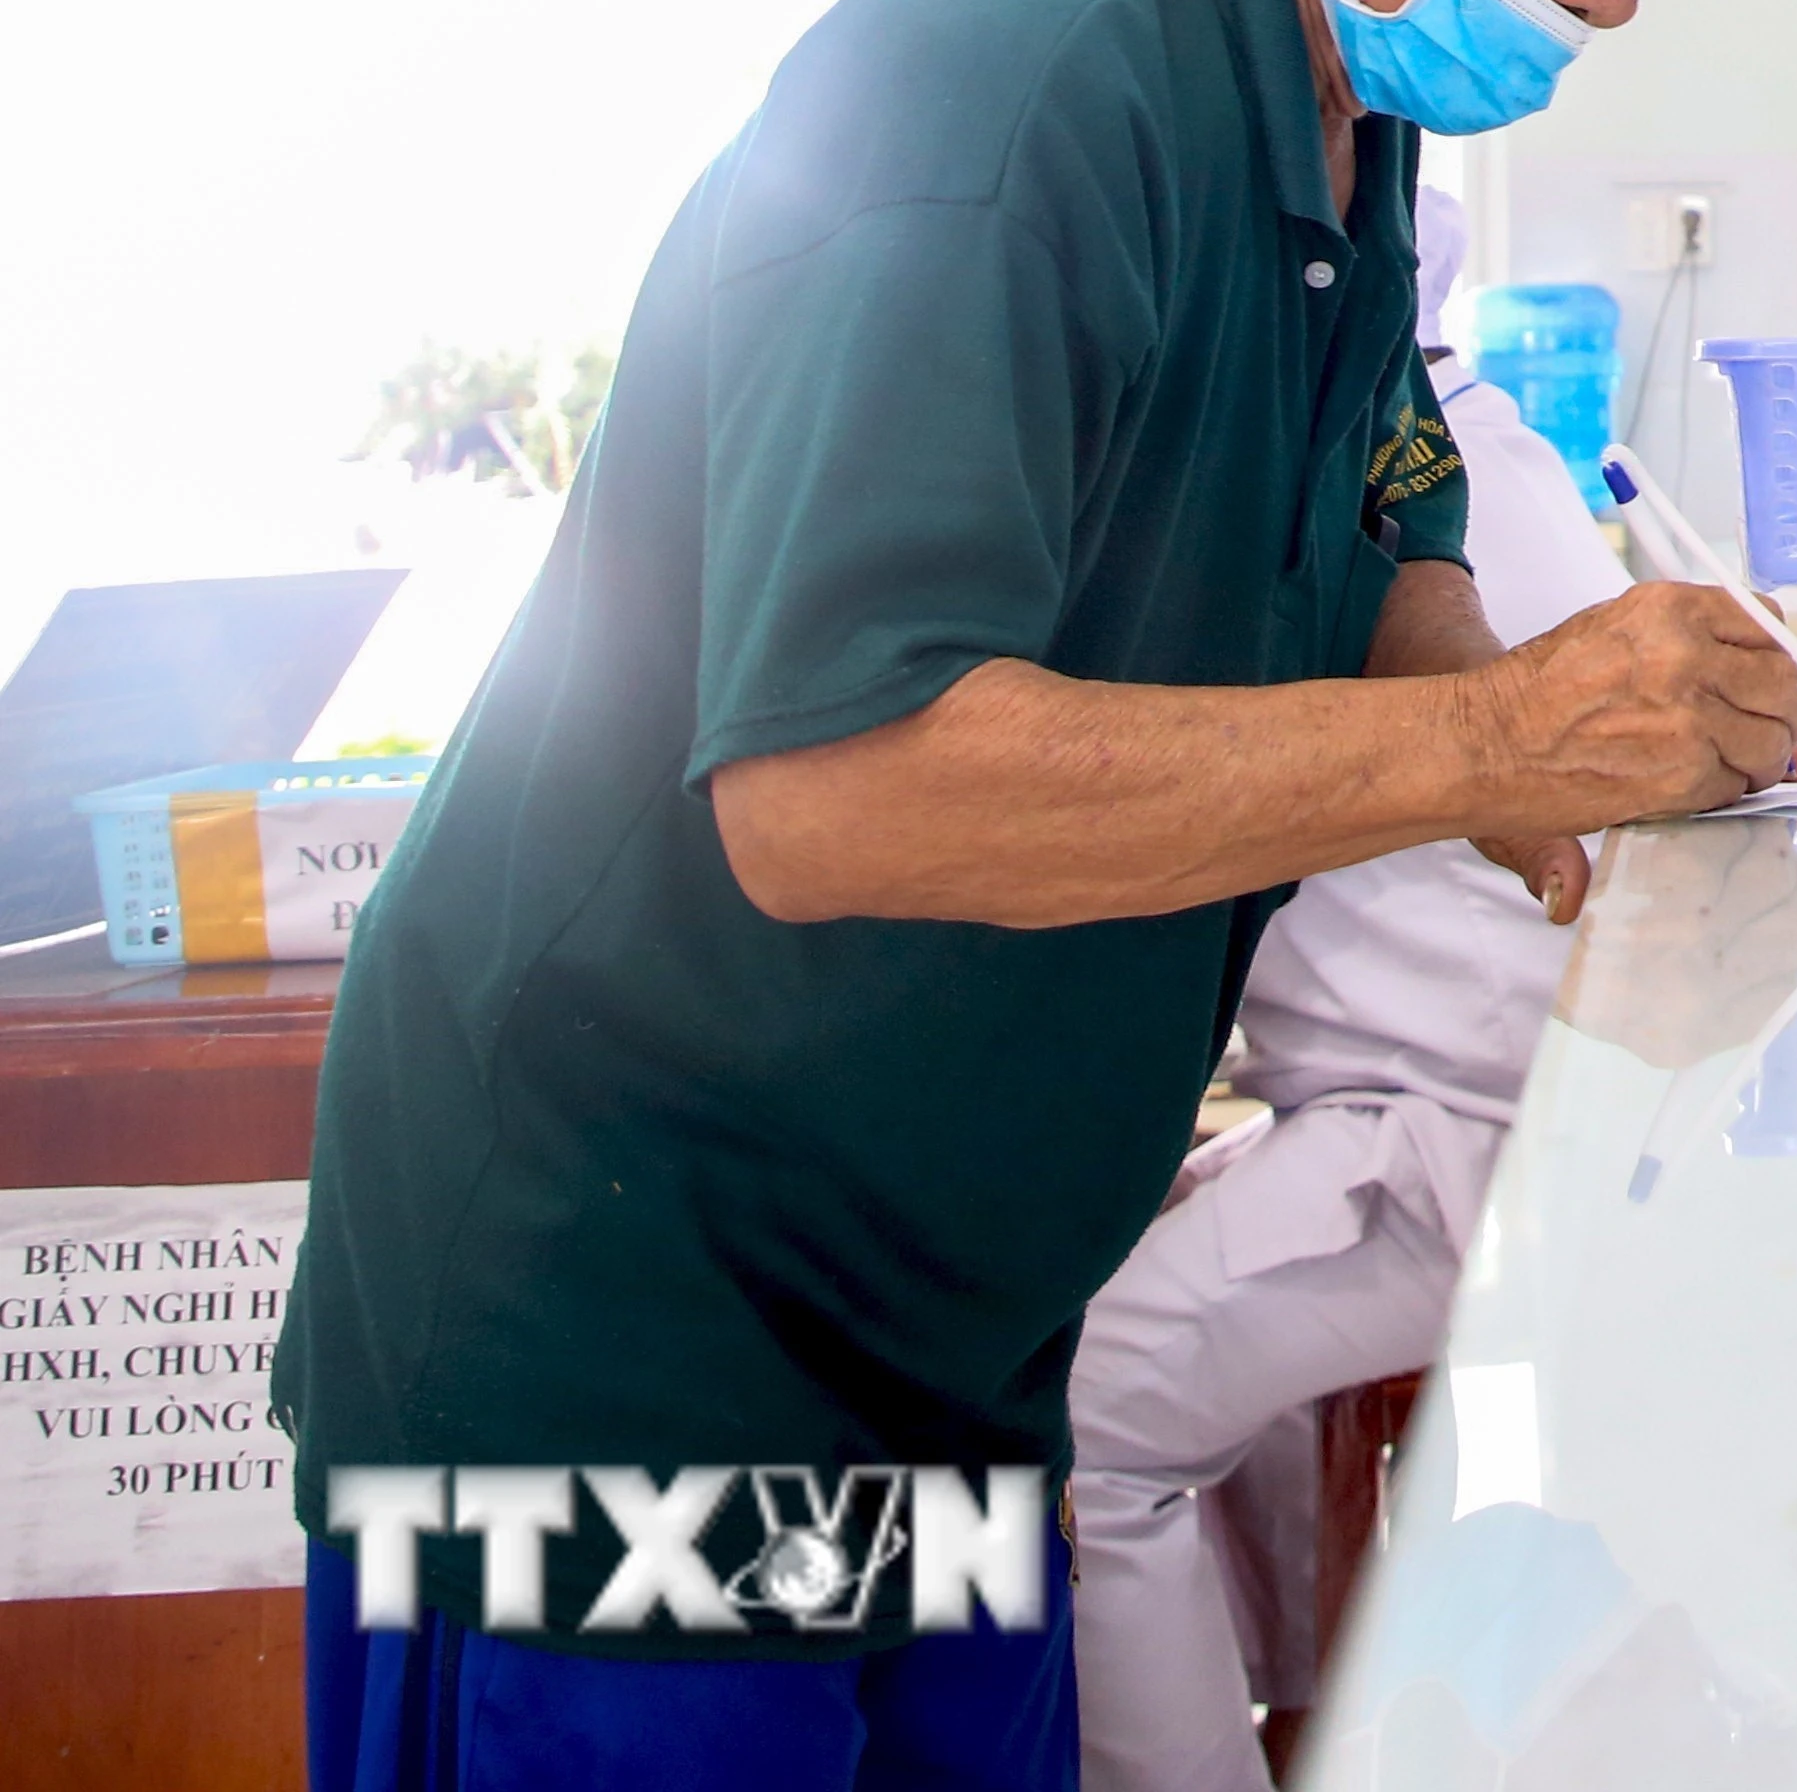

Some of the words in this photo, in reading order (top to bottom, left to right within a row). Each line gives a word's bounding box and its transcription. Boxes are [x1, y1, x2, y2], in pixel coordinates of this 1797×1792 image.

[22, 1238, 144, 1282] BỆNH
[156, 1227, 284, 1272] NHÂN
[0, 1286, 108, 1330] GIẤY
[121, 1281, 237, 1326] NGHỈ
[35, 1405, 113, 1439] VUI
[126, 1394, 254, 1437] LÒNG
[106, 1465, 151, 1497] 30
[163, 1450, 284, 1493] PHÚT
